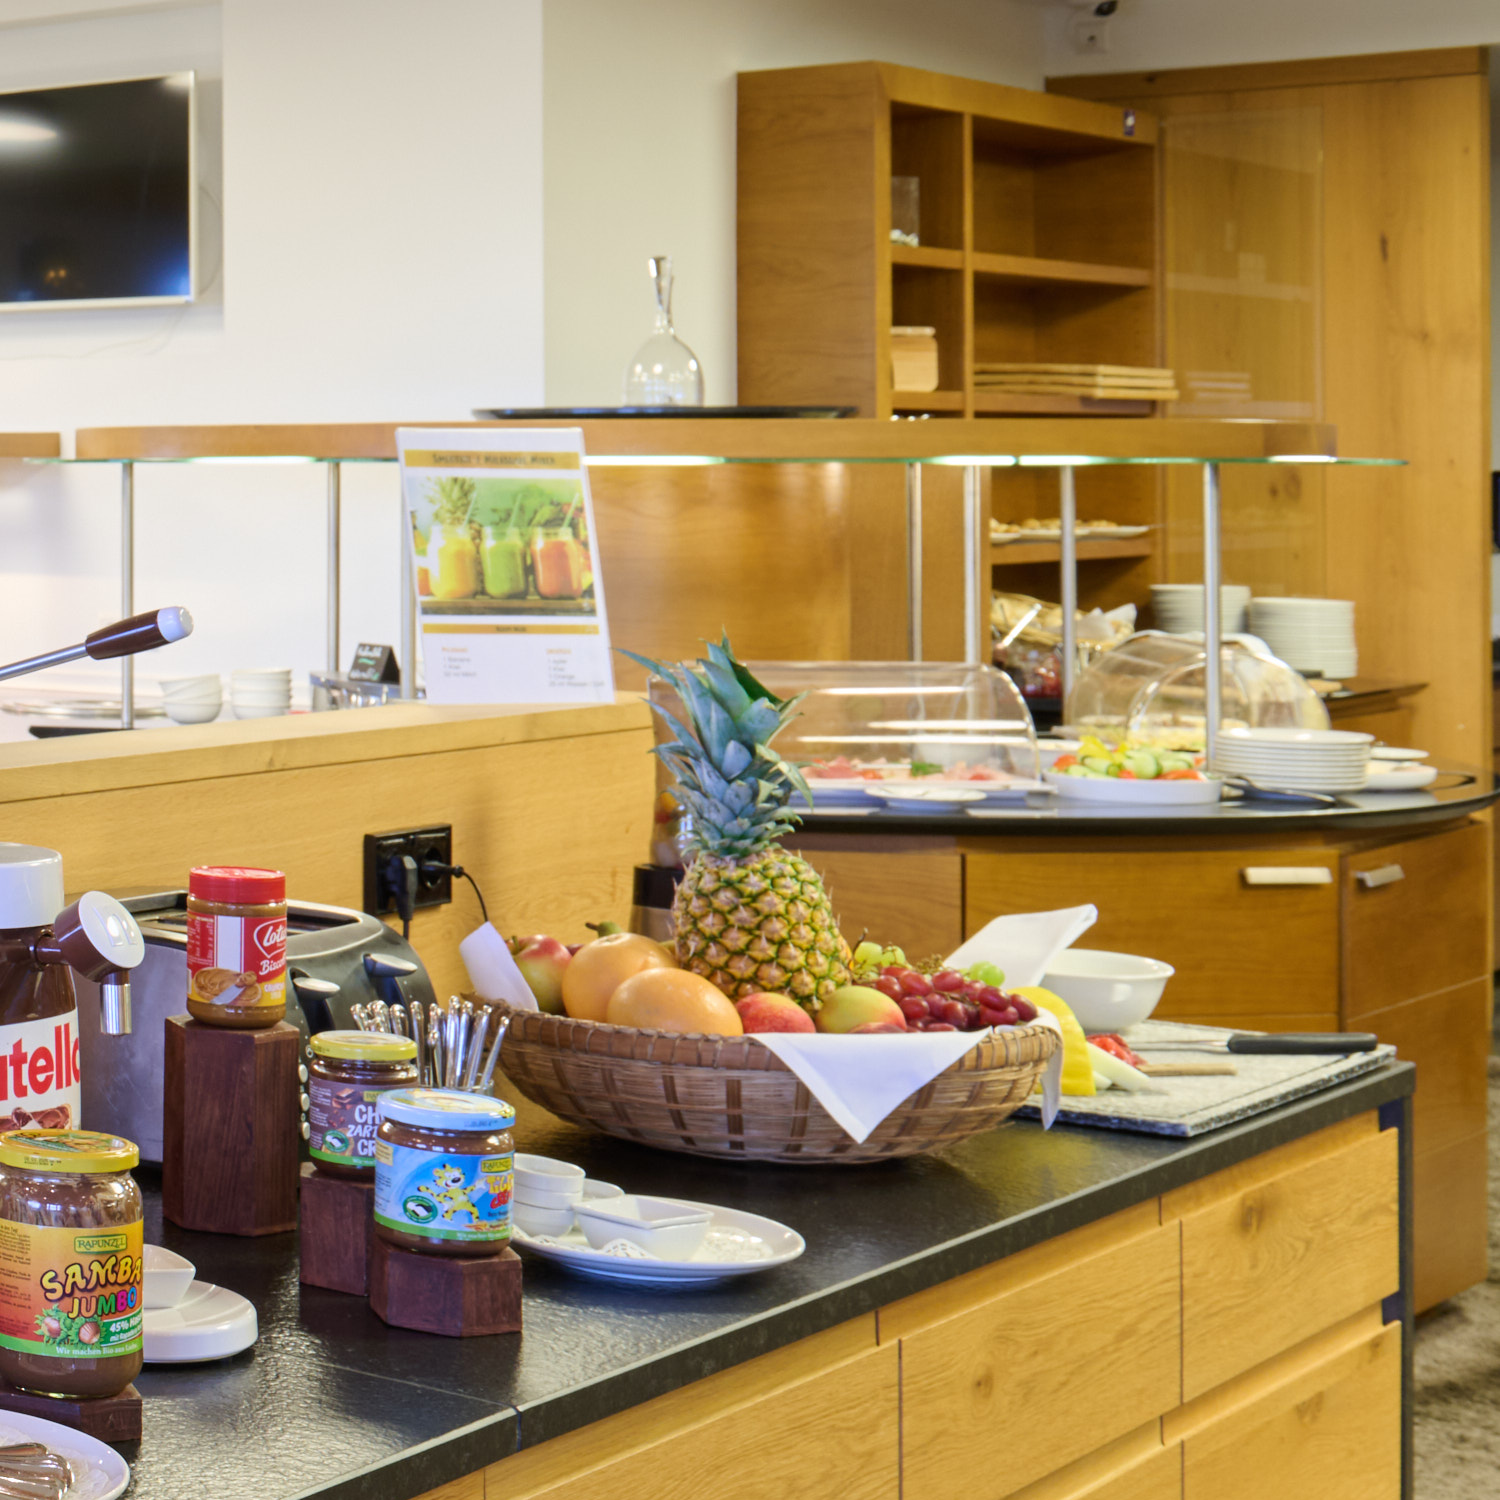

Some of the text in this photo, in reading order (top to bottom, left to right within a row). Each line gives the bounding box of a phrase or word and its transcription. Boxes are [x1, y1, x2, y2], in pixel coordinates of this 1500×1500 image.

[77, 1238, 125, 1250] RAPUNZEL
[40, 1254, 141, 1301] SAMBA
[67, 1286, 137, 1319] JUMBO
[109, 1319, 129, 1332] 45%
[56, 1346, 71, 1355] Wir
[103, 1346, 114, 1354] Bio
